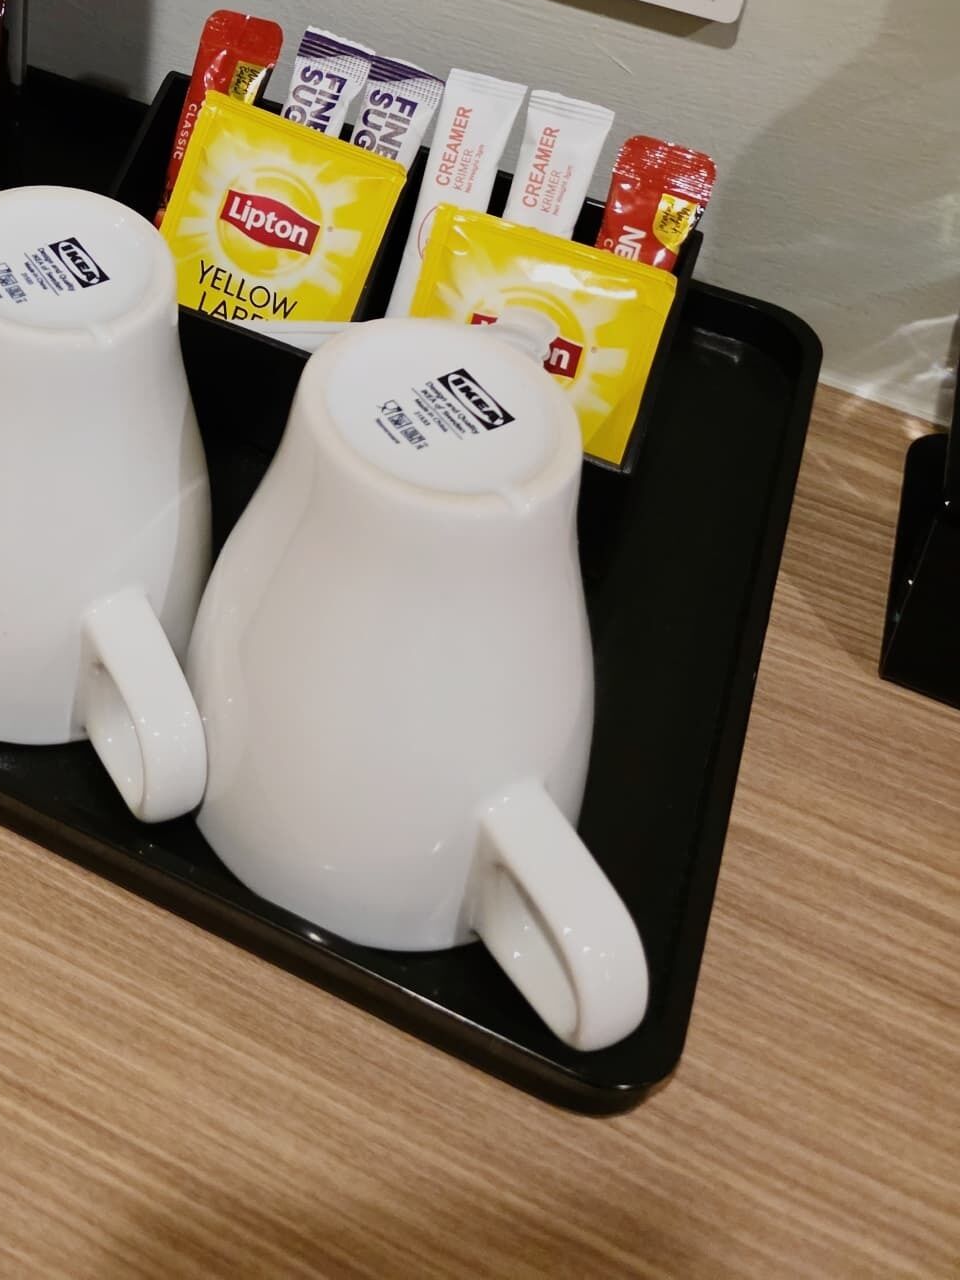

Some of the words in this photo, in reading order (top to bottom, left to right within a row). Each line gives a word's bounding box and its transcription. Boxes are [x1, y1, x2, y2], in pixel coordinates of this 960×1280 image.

[284, 65, 324, 123] SUG
[173, 103, 197, 160] CLASSIC
[353, 88, 394, 151] SUG
[436, 106, 472, 186] CREAMER
[453, 148, 474, 191] KRIMER
[522, 126, 560, 208] CREAMER
[539, 169, 561, 212] KRIMER
[228, 196, 309, 246] Lipton
[60, 244, 98, 282] IKEA
[197, 290, 268, 321] LAB
[198, 259, 298, 319] YELLOW
[414, 398, 429, 412] Made
[432, 417, 449, 432] China
[421, 389, 437, 403] IKEA
[441, 410, 466, 433] Sweden
[424, 381, 447, 402] Design
[445, 401, 459, 413] and
[456, 413, 480, 434] Quality
[451, 377, 500, 424] IKEA
